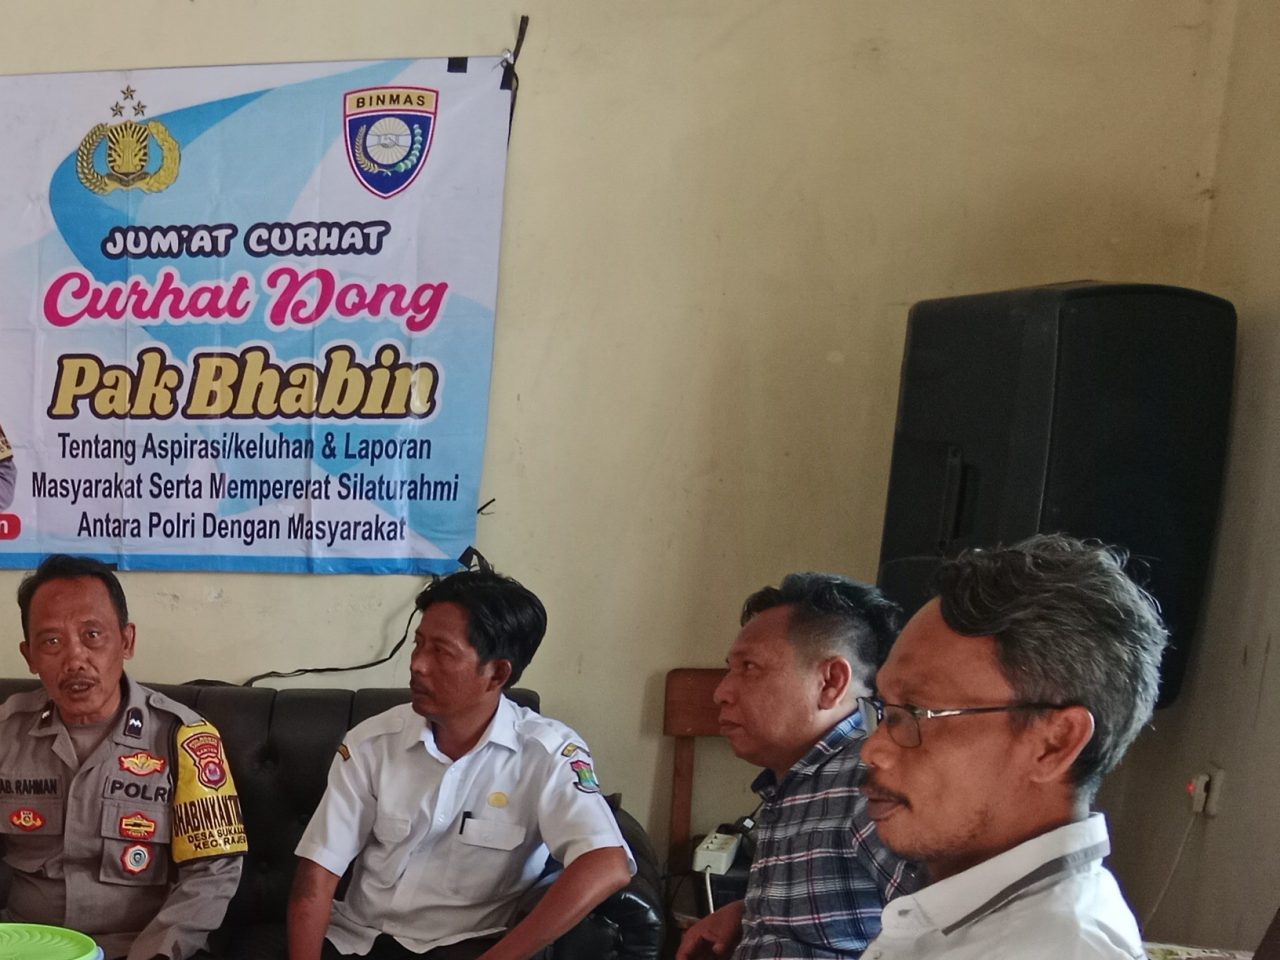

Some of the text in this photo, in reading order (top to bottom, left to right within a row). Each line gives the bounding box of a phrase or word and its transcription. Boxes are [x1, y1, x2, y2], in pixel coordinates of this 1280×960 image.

[356, 93, 426, 109] BINMAS
[105, 224, 387, 254] JUM'AT CURHAT
[43, 267, 449, 333] Curhat Dong
[47, 343, 440, 420] Pak Bhabin
[58, 432, 432, 465] Tentang Aspirasi/keluhan & Laporan
[32, 472, 459, 504] Masyarakat Serta Mempererat Silaturahmi
[78, 513, 407, 547] Antara Polri Dengan Masyarakat
[0, 778, 57, 795] AB. RAHMAN
[187, 832, 214, 844] DESA
[194, 840, 221, 851] KEC.
